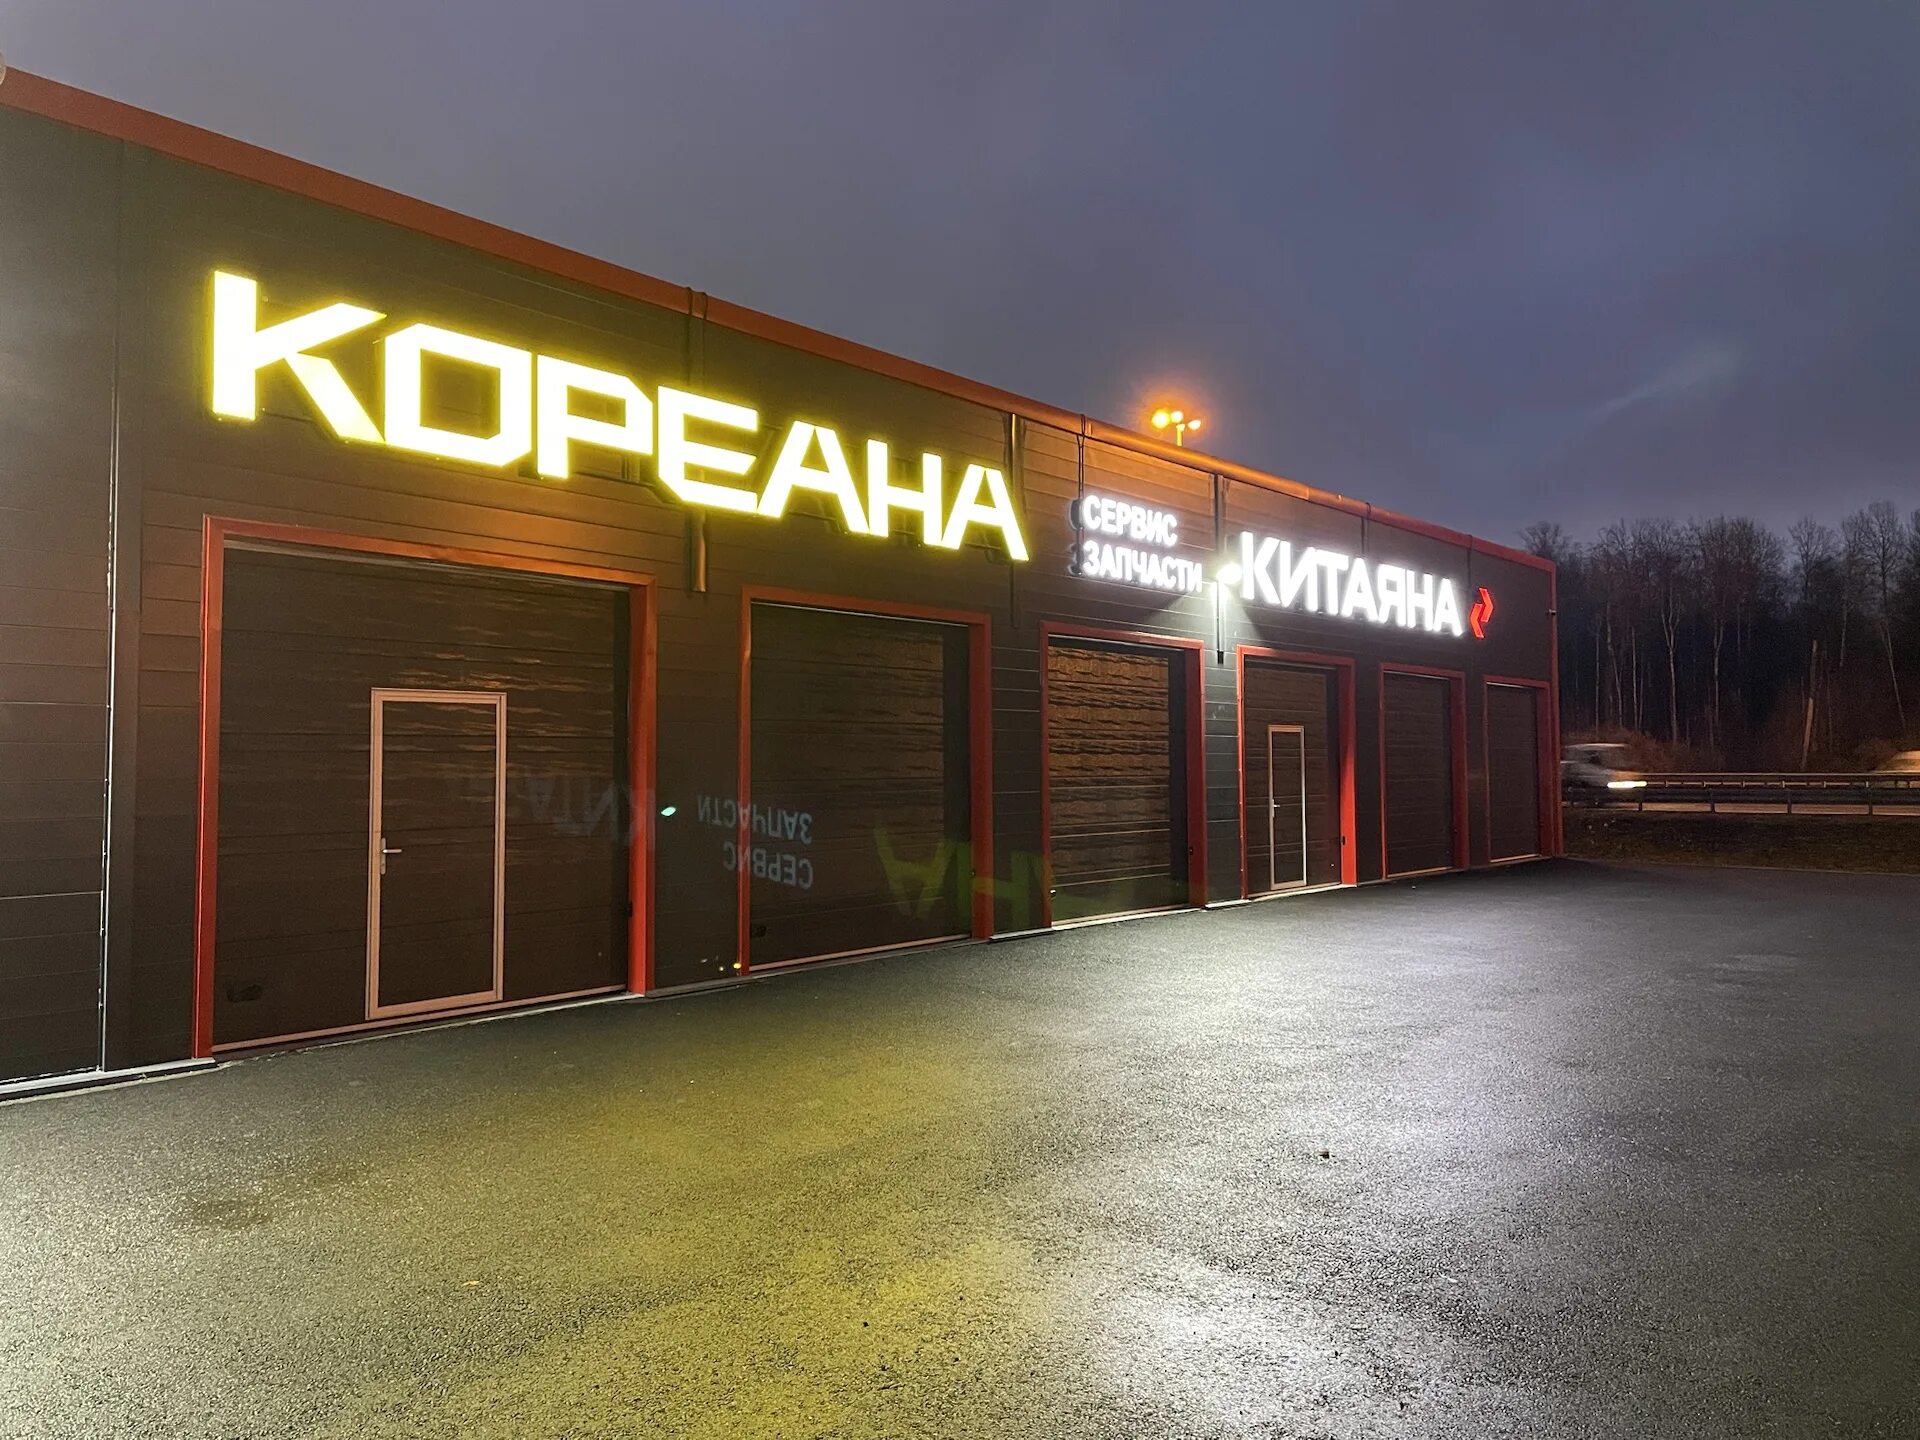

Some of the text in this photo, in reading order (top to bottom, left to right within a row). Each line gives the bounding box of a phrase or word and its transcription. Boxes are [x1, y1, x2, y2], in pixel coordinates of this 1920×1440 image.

[210, 270, 1029, 561] КОРЕАНА
[1083, 495, 1178, 547] СЕРВИС
[1083, 539, 1202, 593] ЗАПЧАСТИ
[1240, 531, 1463, 637] КИТАЯНА
